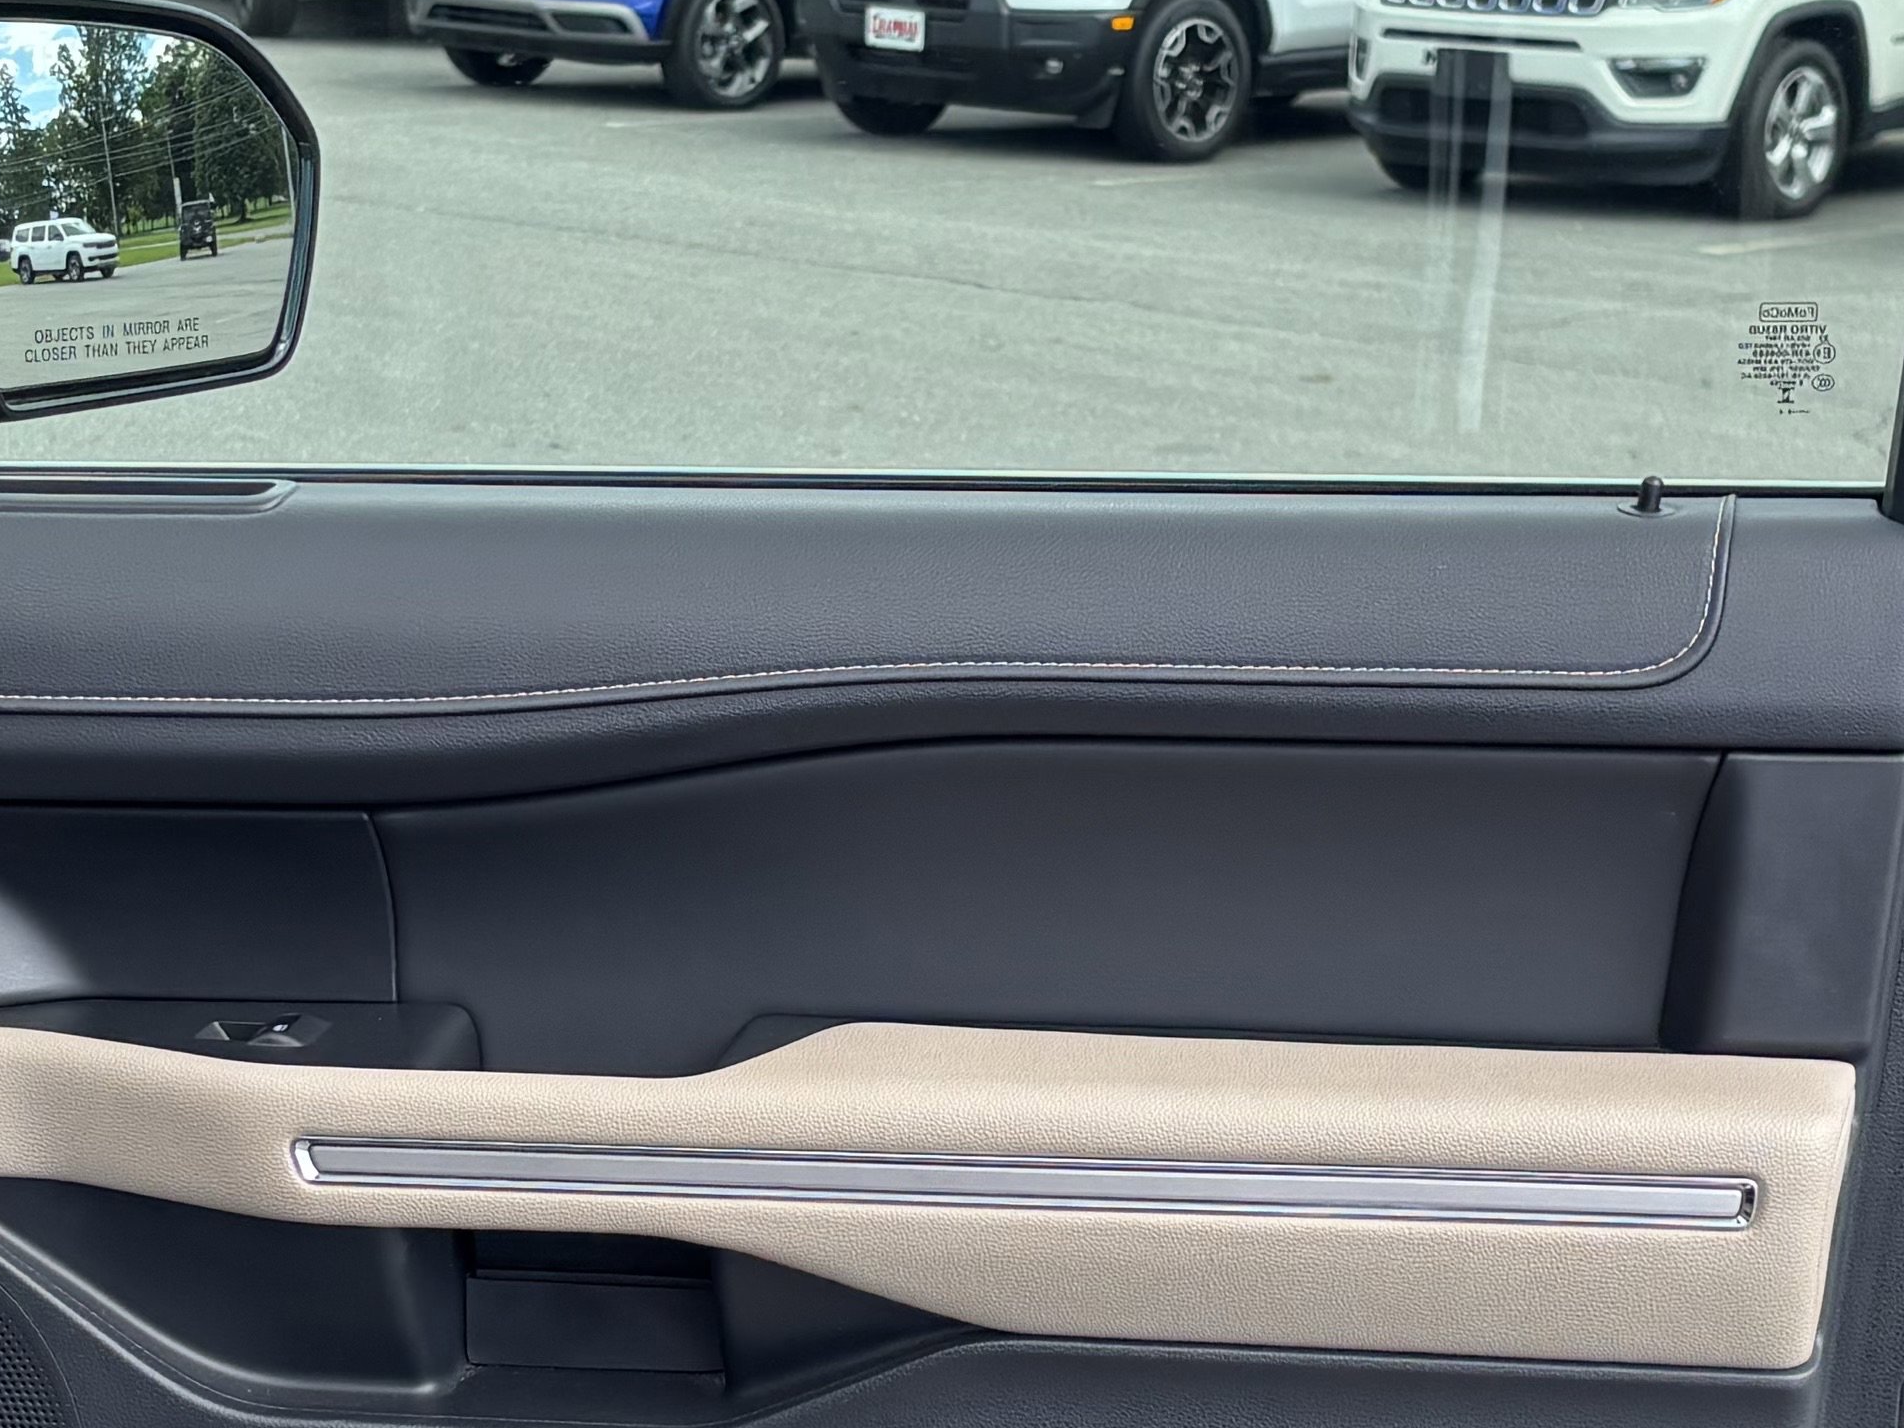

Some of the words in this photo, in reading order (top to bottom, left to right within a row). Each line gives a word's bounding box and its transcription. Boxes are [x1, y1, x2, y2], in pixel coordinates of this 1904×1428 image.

[34, 326, 95, 344] OBJECTS
[102, 324, 115, 339] IN
[123, 320, 171, 337] MIRROR
[177, 317, 200, 333] ARE
[24, 345, 77, 363] CLOSER
[84, 343, 119, 359] THAN
[125, 339, 157, 355] THEY
[162, 334, 209, 352] APPEAR
